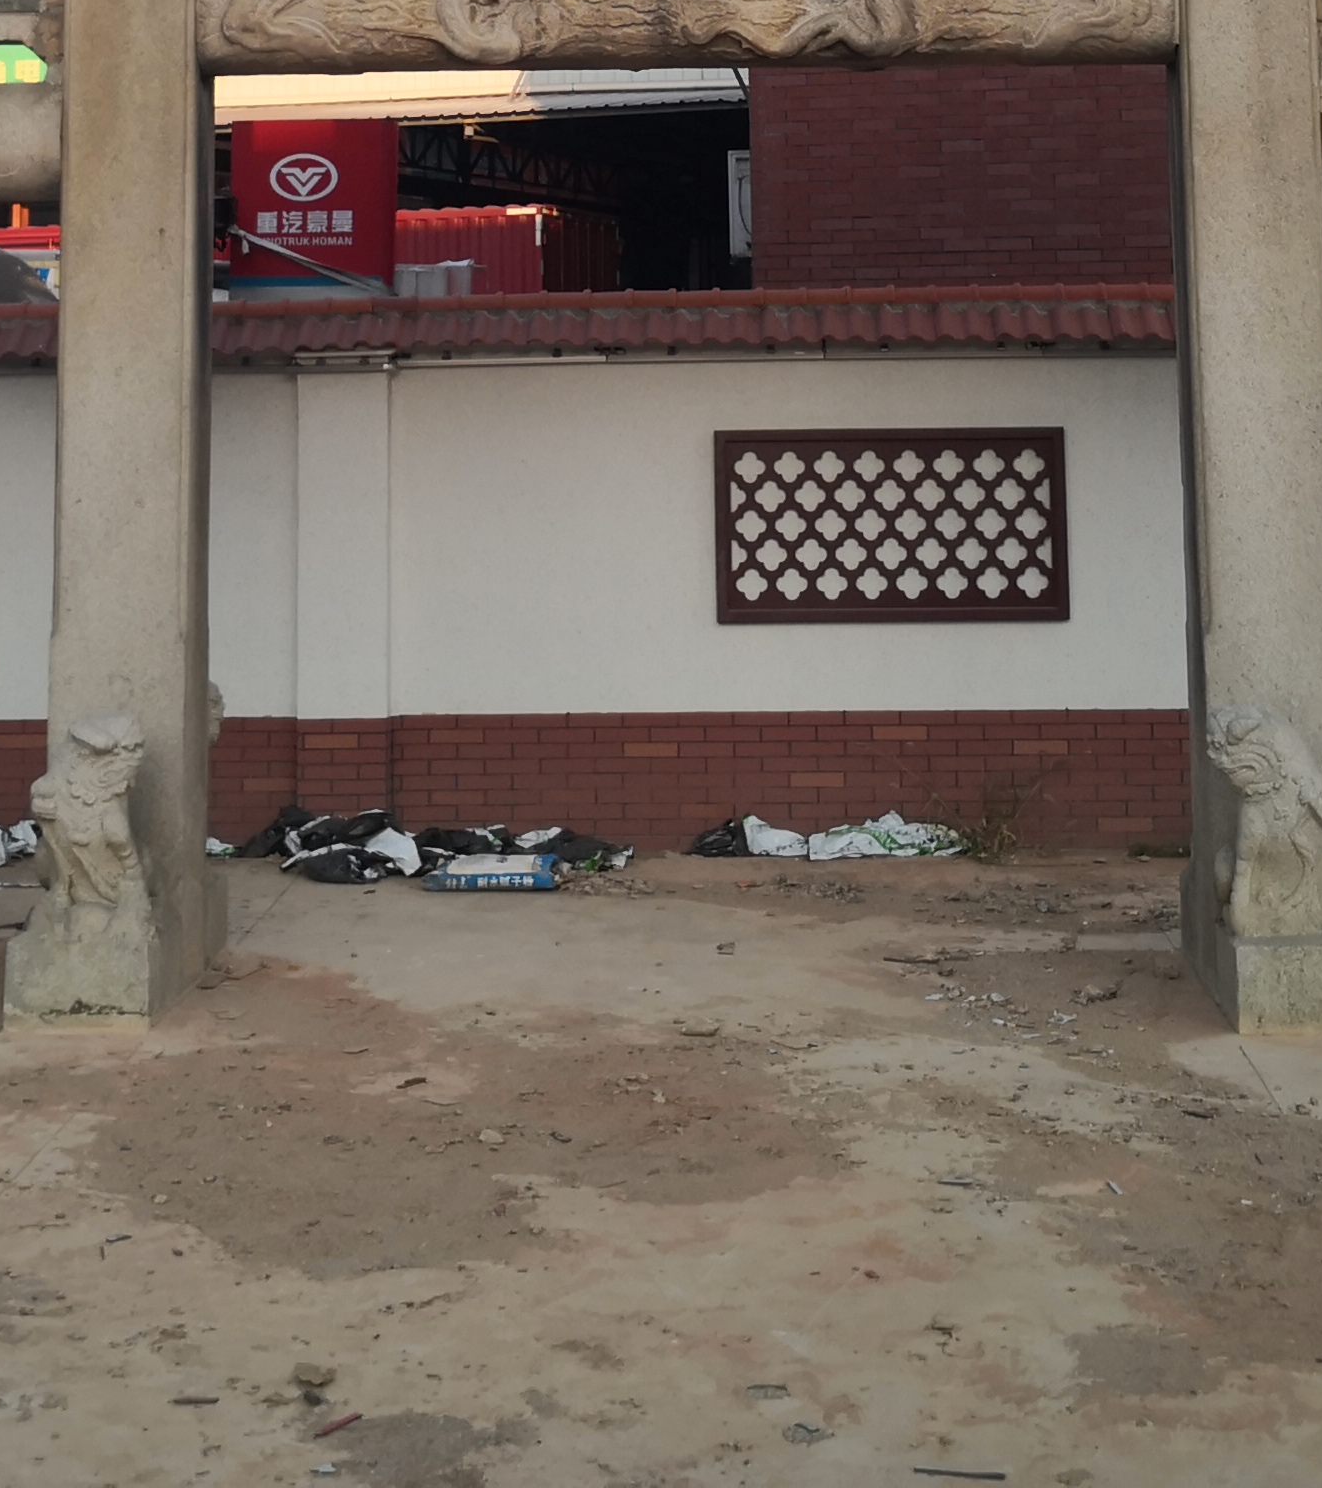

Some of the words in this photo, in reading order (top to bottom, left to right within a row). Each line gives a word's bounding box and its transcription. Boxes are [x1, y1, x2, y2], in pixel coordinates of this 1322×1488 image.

[257, 210, 353, 234] 重汽豪曼
[261, 237, 309, 246] NOTRUK
[312, 237, 353, 246] HOMAN
